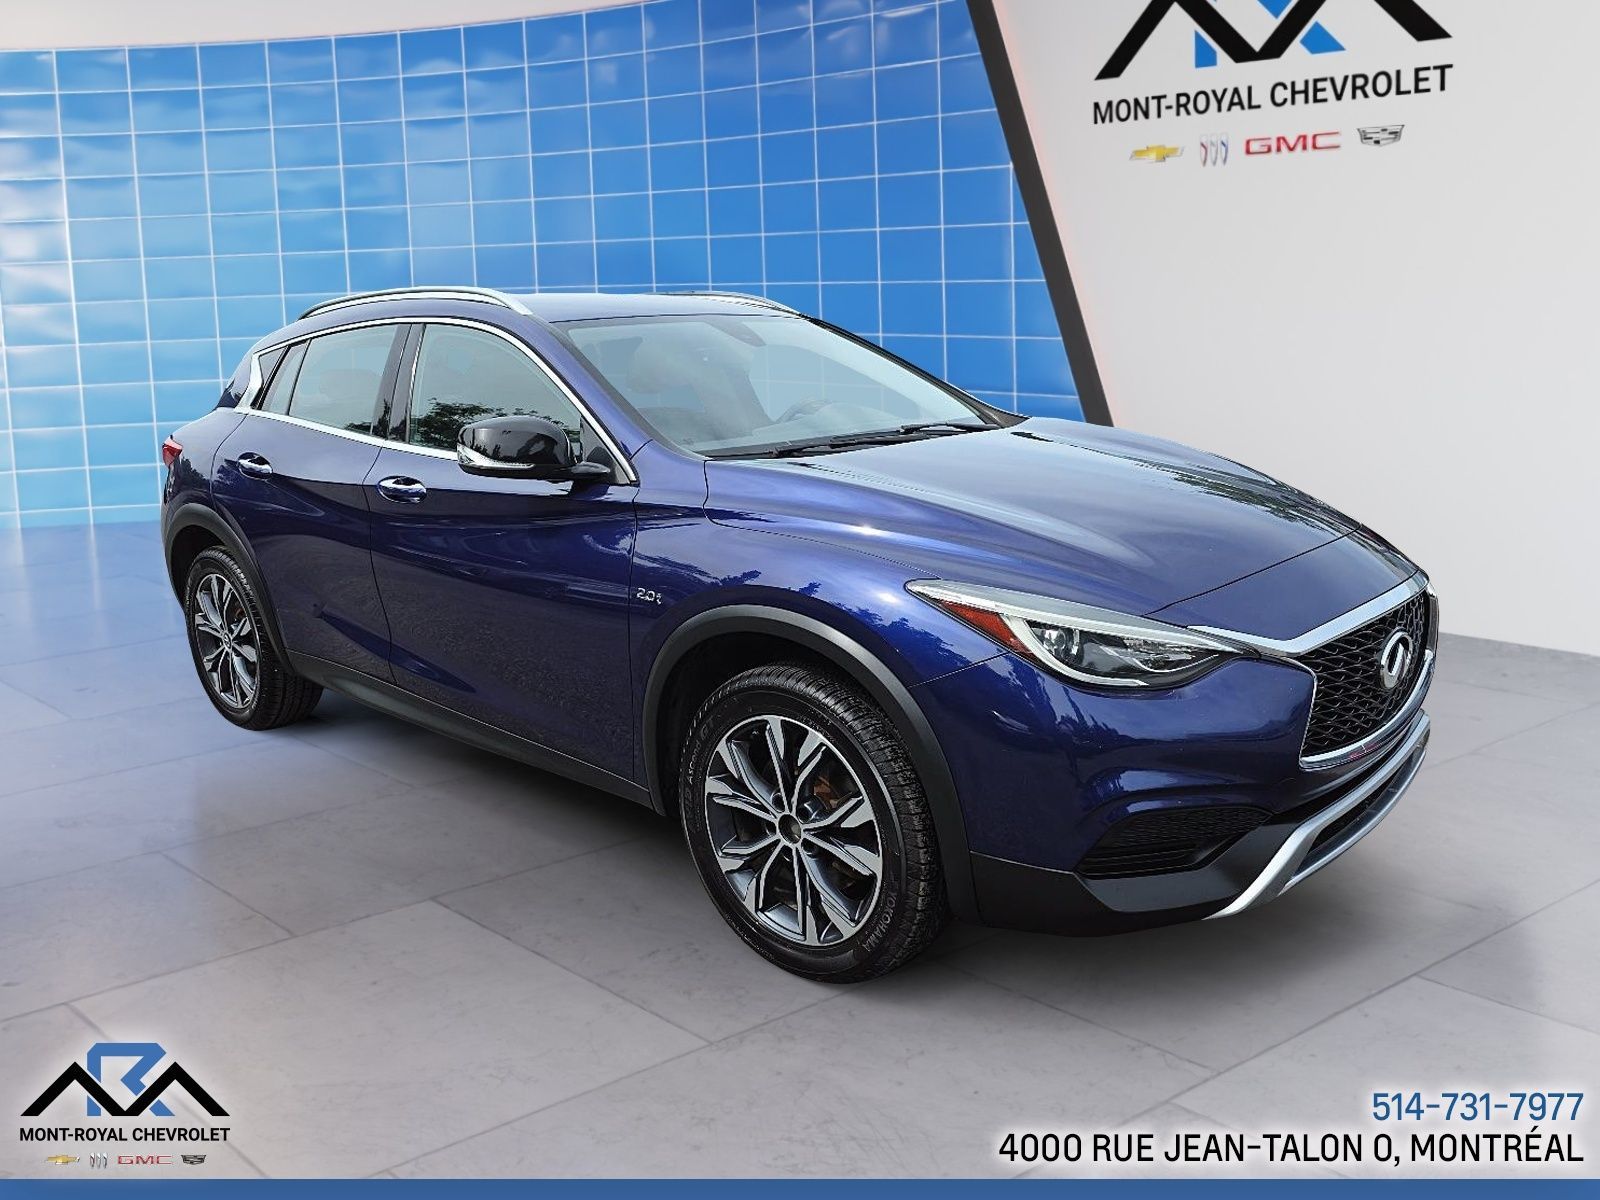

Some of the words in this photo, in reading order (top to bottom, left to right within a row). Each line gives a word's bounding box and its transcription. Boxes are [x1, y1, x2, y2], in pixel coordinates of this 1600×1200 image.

[1093, 85, 1261, 125] MONT-ROYAL
[1269, 63, 1454, 108] CHEVROLET
[1244, 131, 1341, 156] GMC
